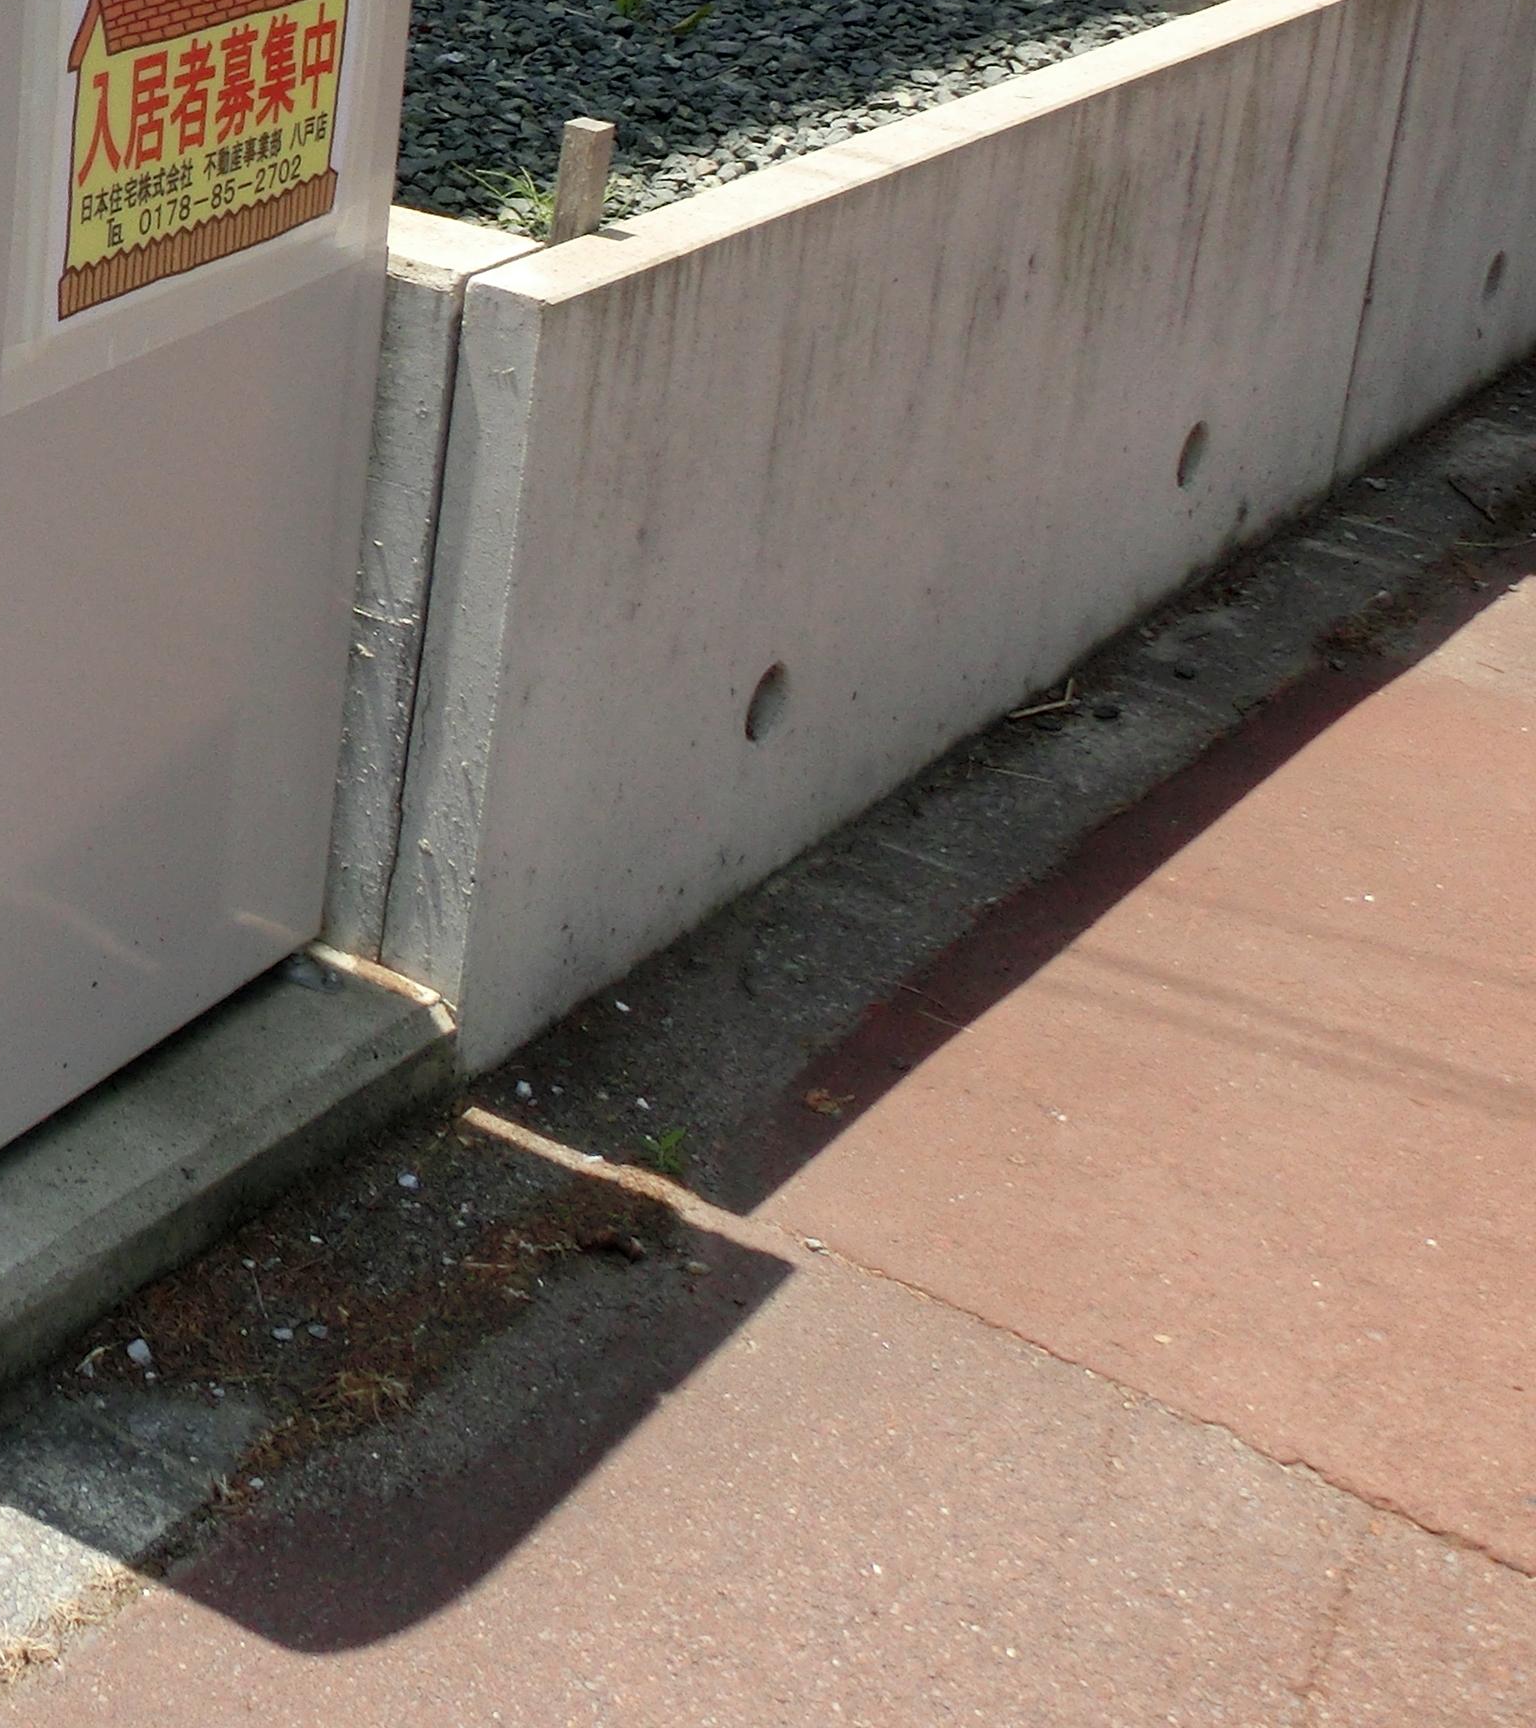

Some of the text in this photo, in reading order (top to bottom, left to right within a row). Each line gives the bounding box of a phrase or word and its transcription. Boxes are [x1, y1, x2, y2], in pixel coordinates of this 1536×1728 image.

[78, 2, 337, 187] 入居者募集中
[80, 111, 328, 224] 日本住宅株式会社 不動産事業部 八戸店
[139, 154, 302, 235] 0178-85-2702
